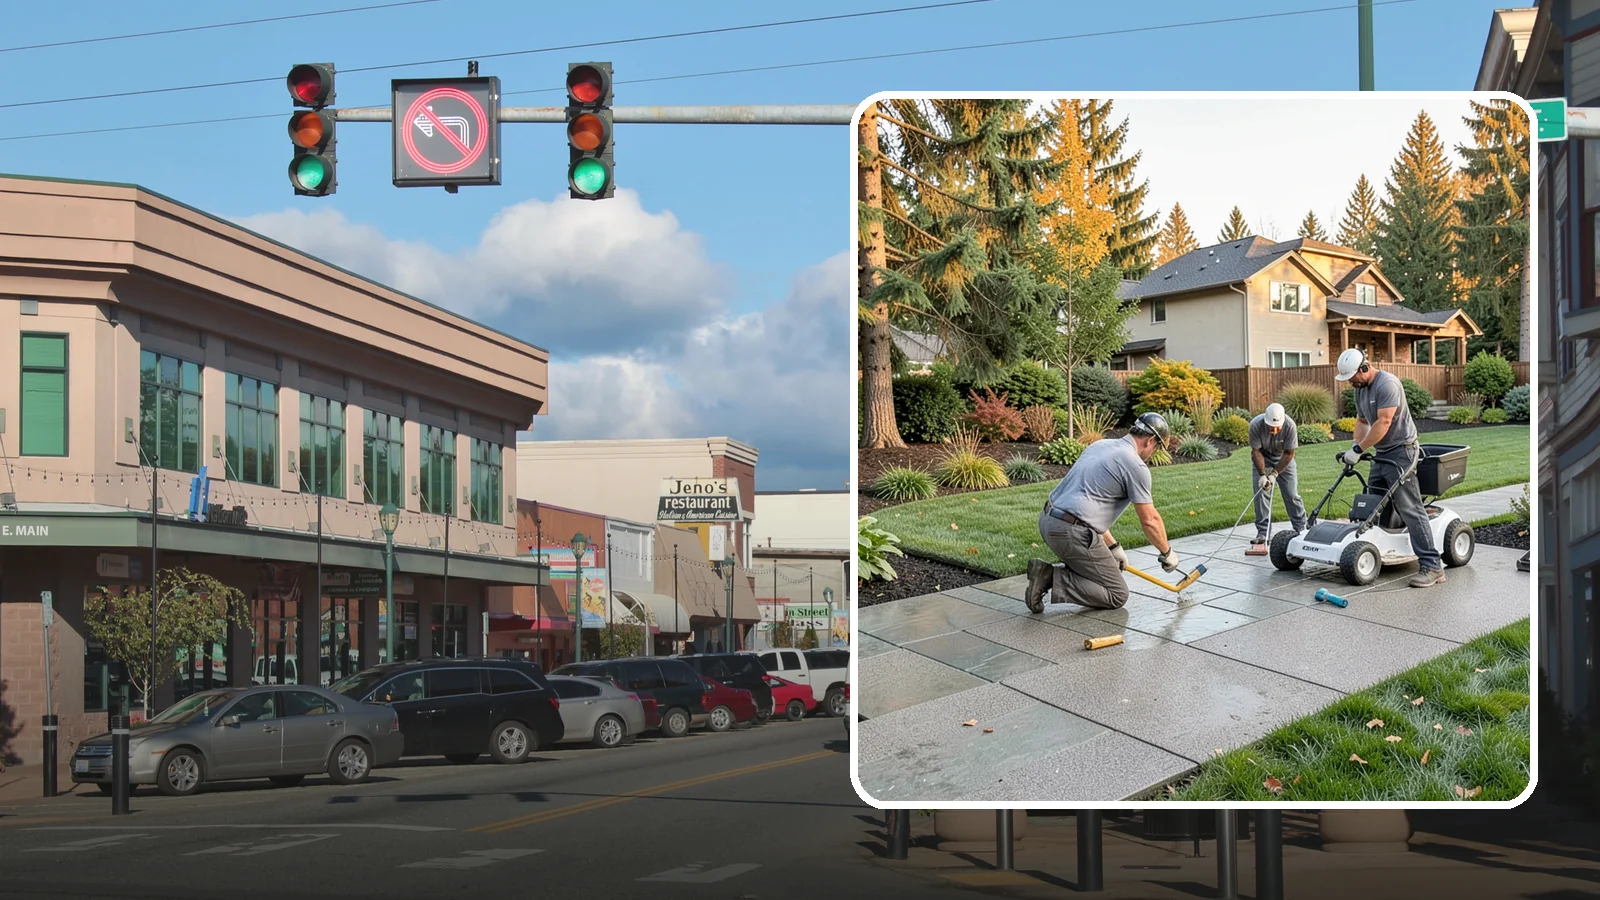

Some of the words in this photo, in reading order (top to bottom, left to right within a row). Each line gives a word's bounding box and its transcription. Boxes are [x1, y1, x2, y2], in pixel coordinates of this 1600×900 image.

[670, 480, 727, 494] Jeno's
[665, 496, 731, 509] restaurant
[658, 510, 681, 519] Italian
[686, 509, 714, 519] American
[715, 509, 738, 519] Cuisine
[2, 525, 12, 536] E.
[16, 525, 48, 536] MAIN
[798, 608, 828, 616] Street
